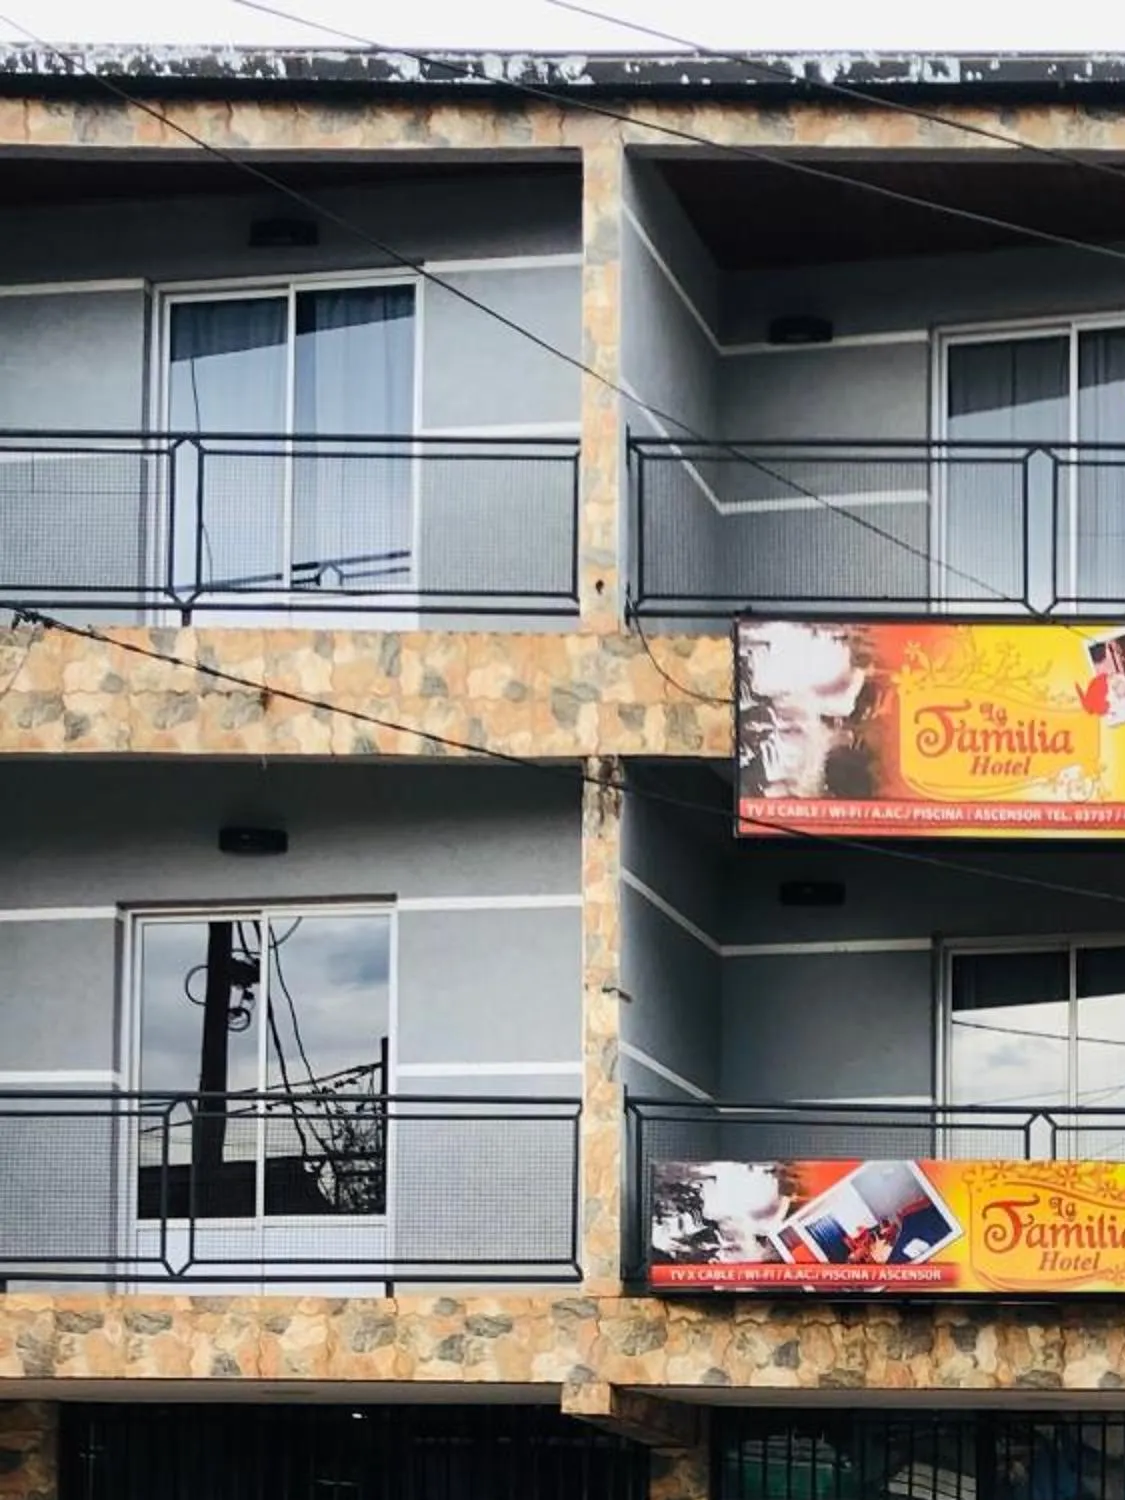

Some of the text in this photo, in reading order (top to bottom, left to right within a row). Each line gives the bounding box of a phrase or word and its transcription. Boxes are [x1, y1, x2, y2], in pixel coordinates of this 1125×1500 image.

[980, 702, 1008, 727] La
[914, 699, 1075, 758] Familia
[970, 756, 1031, 776] Hotel
[777, 804, 819, 818] CABLE
[913, 807, 964, 820] PISCINA
[974, 808, 1041, 821] ASCENSOR
[1047, 808, 1072, 822] TEL.
[1049, 1197, 1077, 1222] La
[1039, 1251, 1100, 1271] Hotel
[699, 1269, 736, 1281] CABLE
[822, 1269, 869, 1281] PISCINA
[879, 1269, 942, 1281] ASCENSOR
